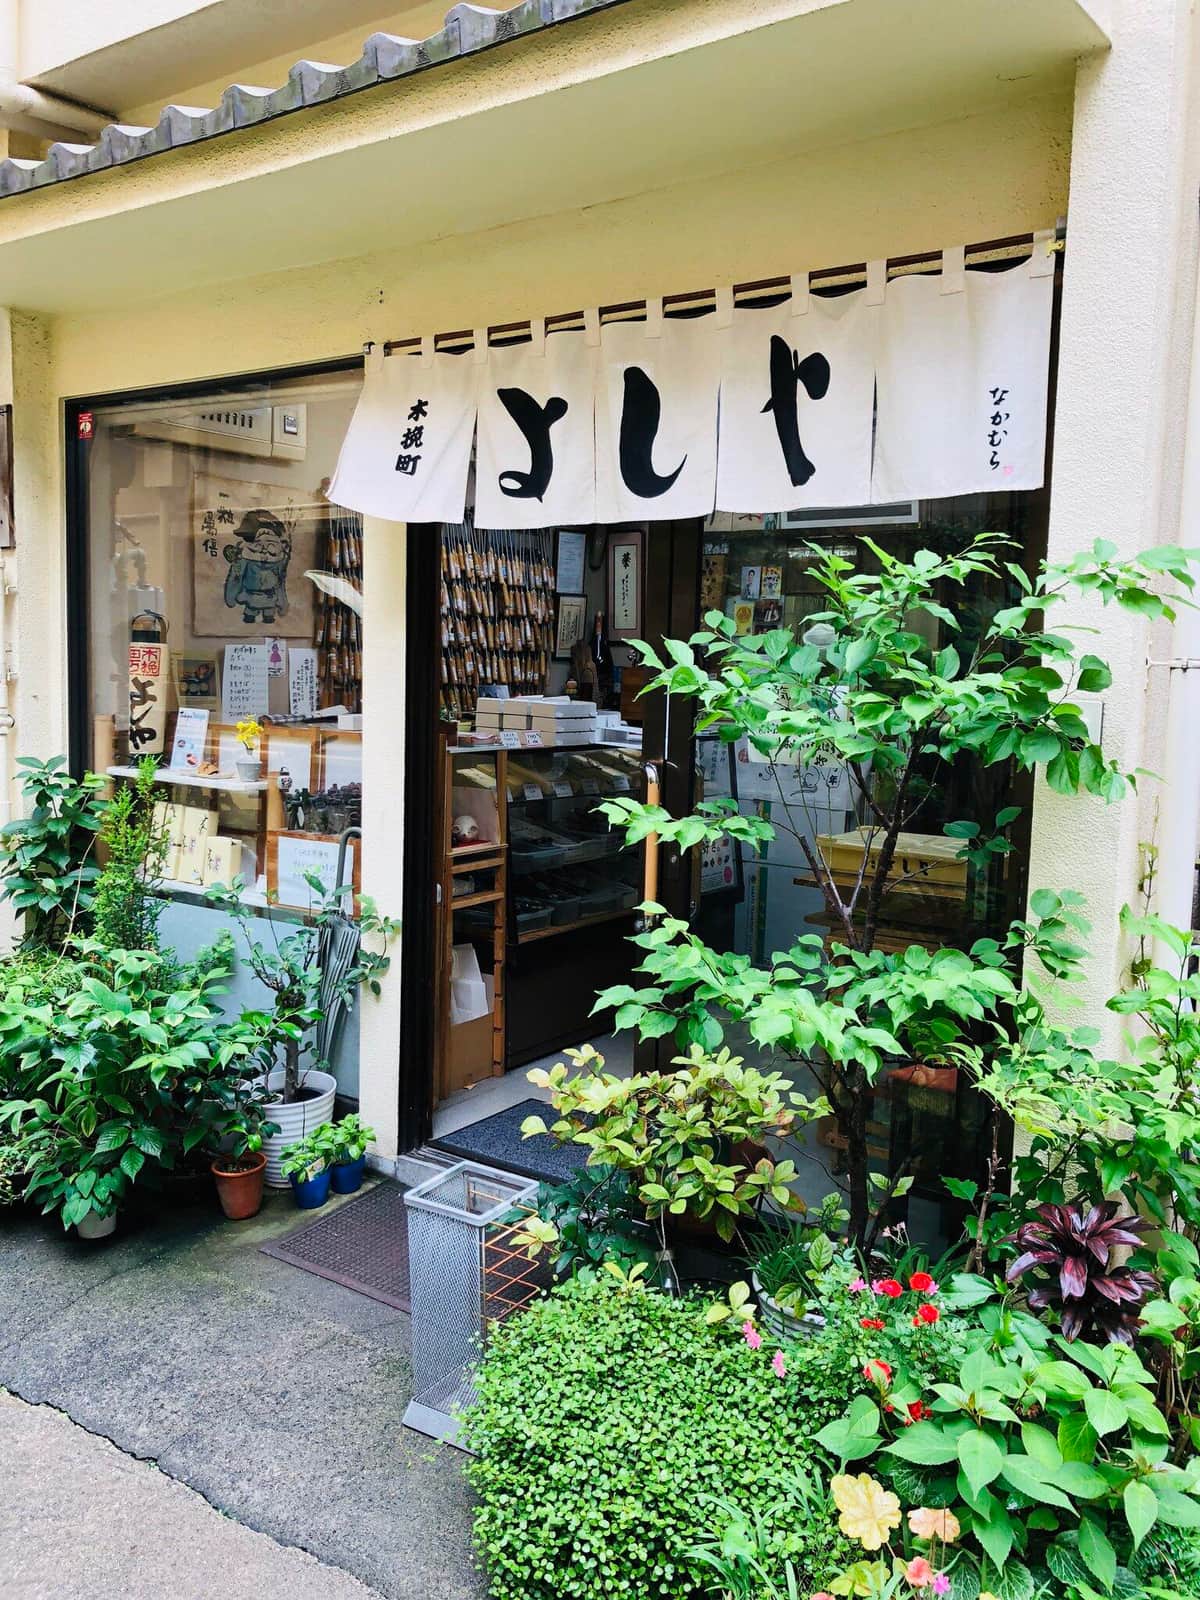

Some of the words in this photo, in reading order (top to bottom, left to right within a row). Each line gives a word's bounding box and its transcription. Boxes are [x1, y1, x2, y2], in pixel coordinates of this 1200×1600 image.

[396, 398, 429, 476] 木挽町
[498, 334, 832, 504] よしや
[987, 386, 1010, 471] なかむら
